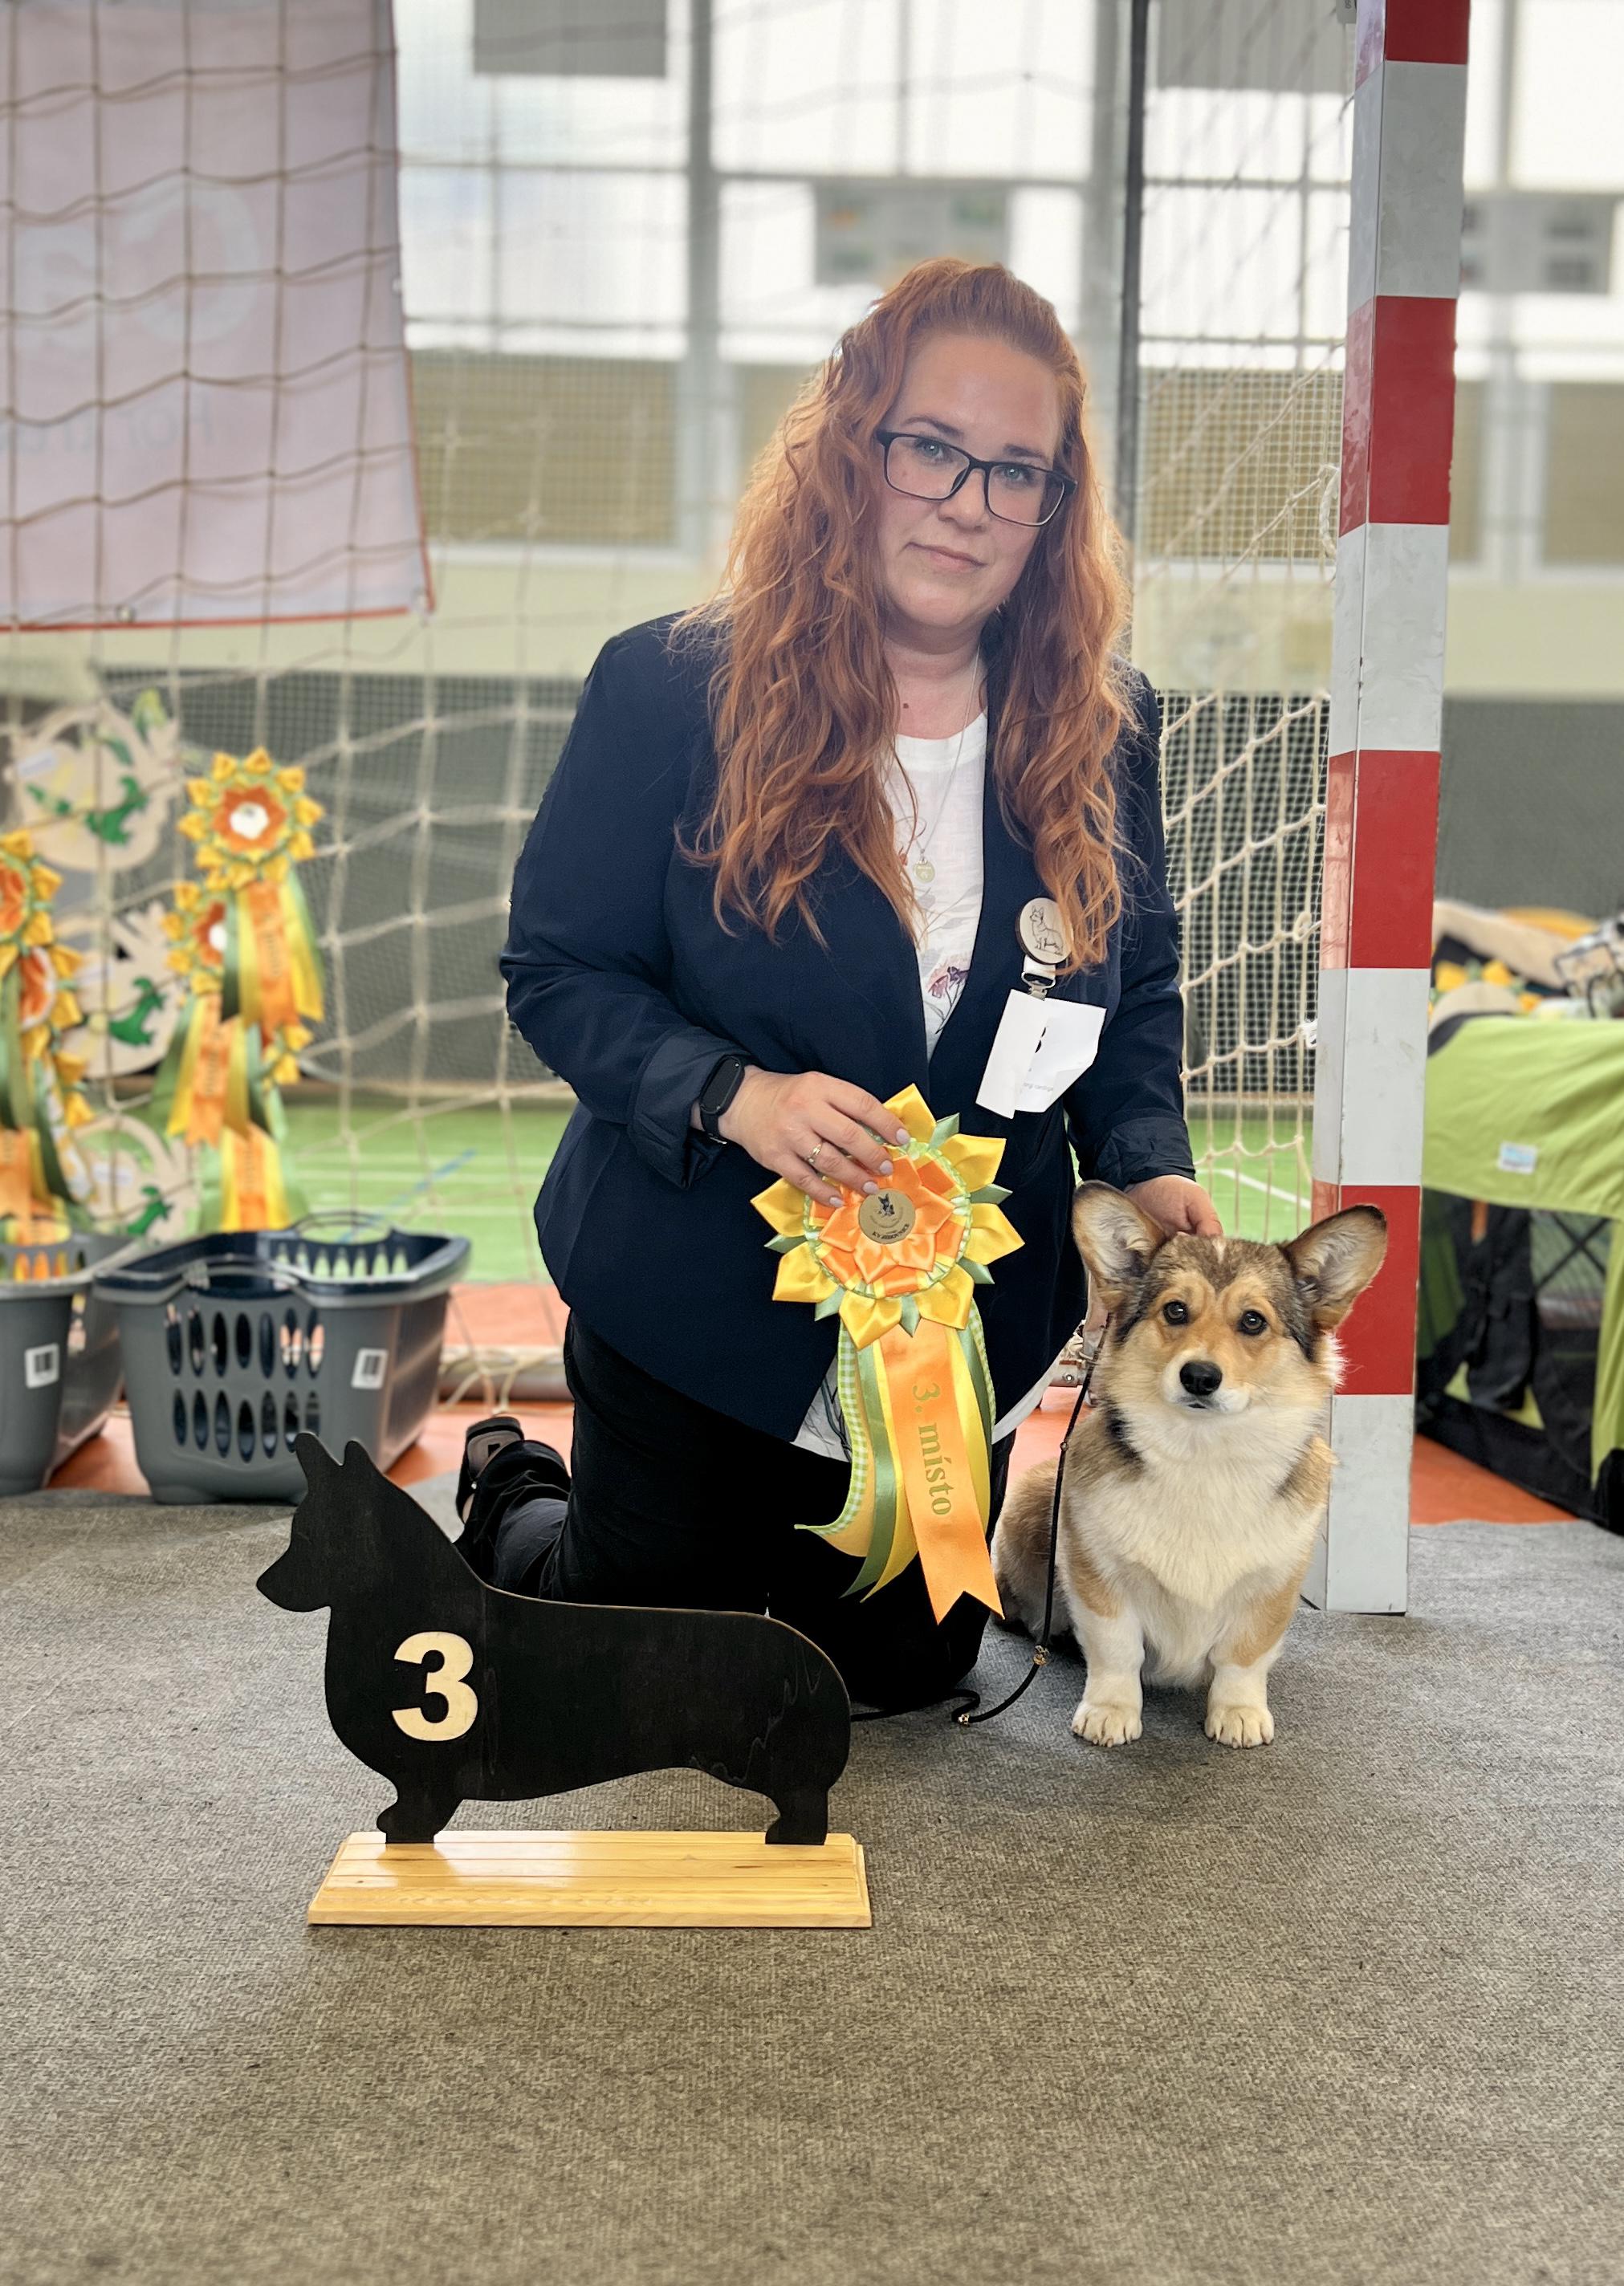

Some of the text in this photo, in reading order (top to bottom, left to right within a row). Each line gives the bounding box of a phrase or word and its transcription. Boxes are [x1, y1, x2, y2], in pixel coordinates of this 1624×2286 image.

[912, 1382, 954, 1515] 3. místo
[391, 1630, 478, 1742] 3
